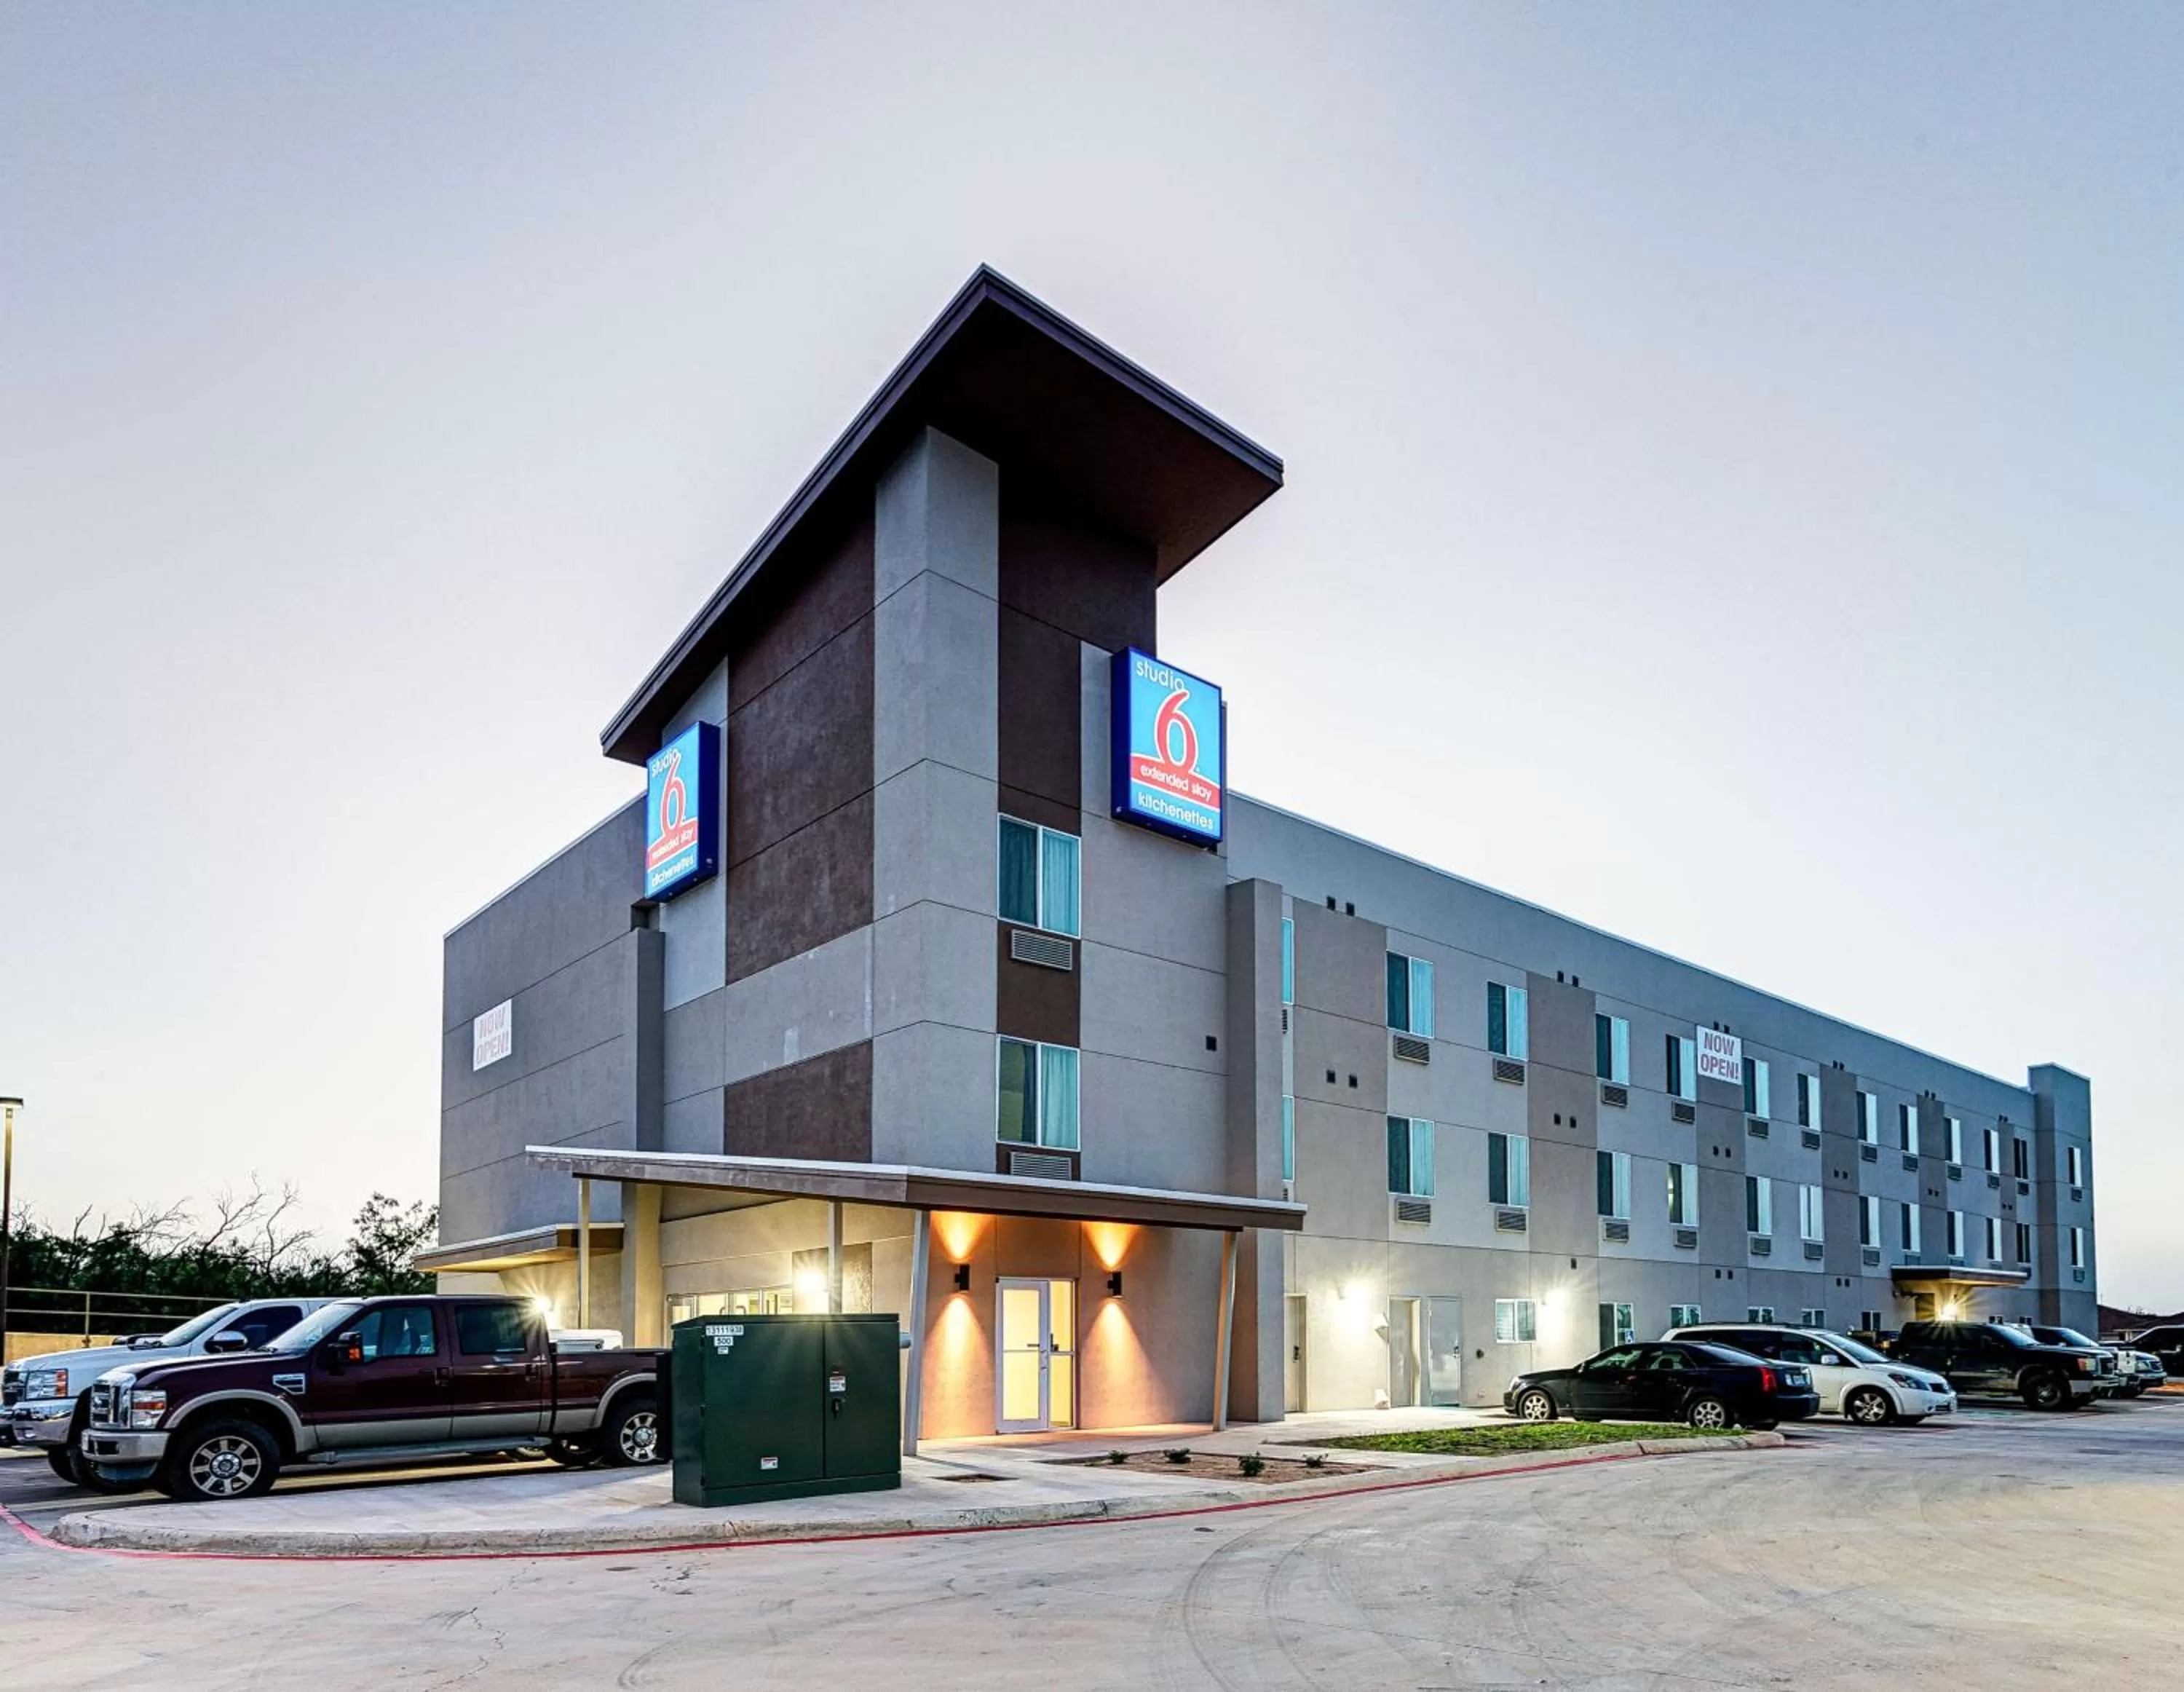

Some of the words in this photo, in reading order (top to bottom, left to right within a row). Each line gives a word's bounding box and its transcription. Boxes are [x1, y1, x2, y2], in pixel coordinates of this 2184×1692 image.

[1136, 660, 1185, 691] studio
[1154, 689, 1198, 772] 6
[660, 751, 687, 834] 6
[1140, 764, 1189, 791] extended
[1192, 781, 1212, 802] stay
[1138, 791, 1214, 830] kitchenettes
[1704, 1031, 1735, 1056] NOW
[1701, 1053, 1739, 1080] OPEN!
